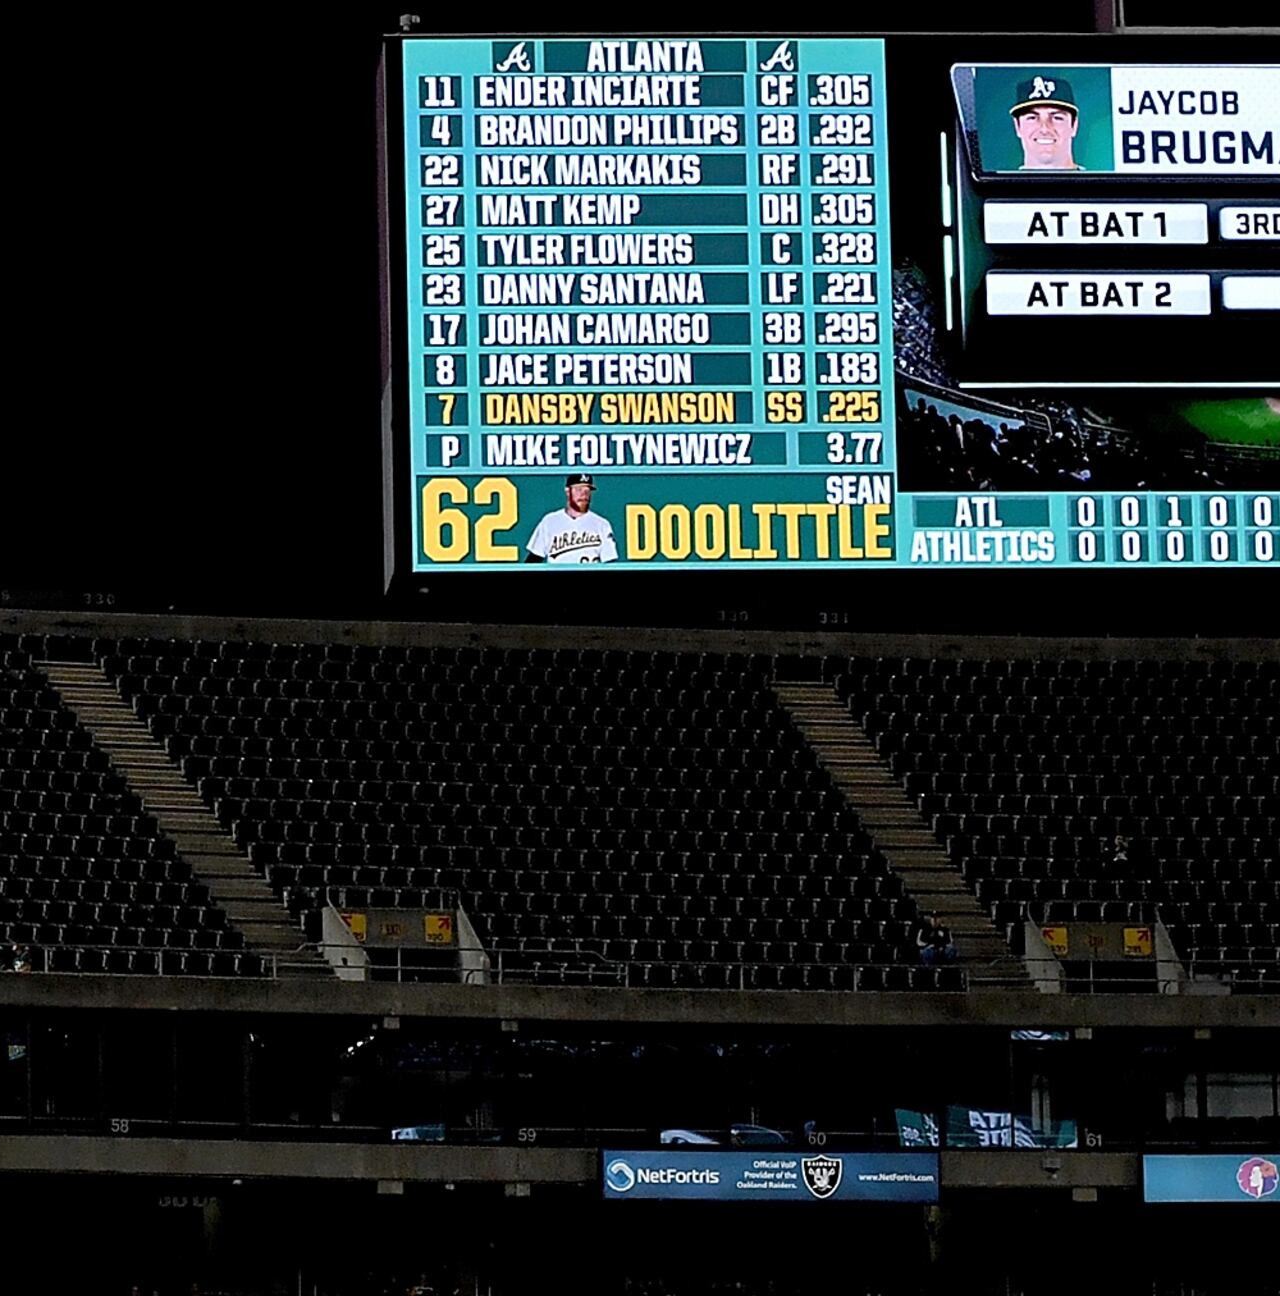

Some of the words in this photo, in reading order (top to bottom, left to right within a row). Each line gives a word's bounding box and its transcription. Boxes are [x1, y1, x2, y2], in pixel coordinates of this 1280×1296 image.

[588, 42, 703, 72] ATLANTA
[480, 76, 566, 106] ENDER
[572, 76, 699, 106] INCIARTE
[1119, 91, 1239, 116] JAYCOB
[481, 115, 609, 145] BRANDON
[615, 115, 737, 145] PHILLIPS
[481, 155, 548, 184] NICK
[556, 155, 700, 184] MARKAKIS
[482, 195, 558, 225] MATT
[563, 195, 641, 225] KEMP
[1028, 212, 1068, 236] AT
[1080, 212, 1145, 236] BAT
[1159, 212, 1167, 236] 1
[482, 235, 564, 263] TYLER
[571, 235, 692, 263] FLOWERS
[484, 274, 573, 303] DANNY
[579, 274, 703, 303] SANTANA
[484, 315, 570, 344] JOHAN
[577, 314, 709, 344] CAMARGO
[486, 394, 591, 423] DANSBY
[601, 394, 734, 423] SWANSON
[487, 434, 561, 464] MIKE
[568, 433, 751, 464] FOLTYNEWICZ
[827, 476, 890, 504] SEAN
[422, 477, 518, 562] 62
[956, 497, 1002, 527] ATL
[626, 504, 891, 558] DOOLITTLE
[911, 531, 1054, 561] ATHLETICS
[638, 1170, 719, 1183] NetFortris
[744, 1171, 774, 1179] Provider
[776, 1171, 783, 1179] of
[785, 1171, 797, 1179] the
[859, 1173, 933, 1182] www.NetFortris.com
